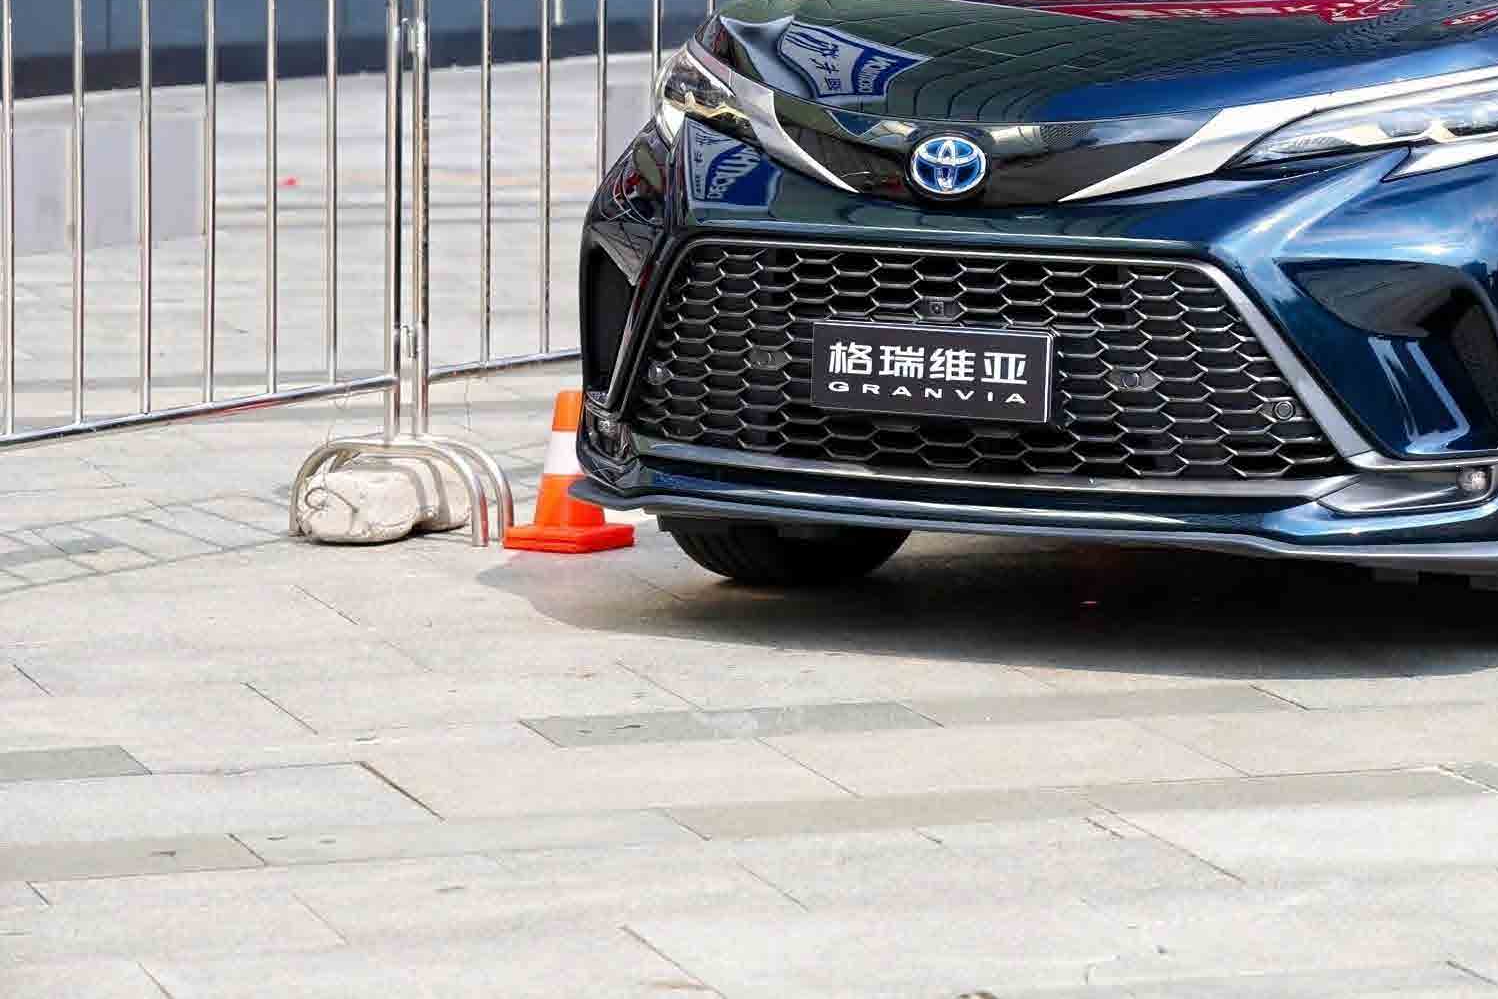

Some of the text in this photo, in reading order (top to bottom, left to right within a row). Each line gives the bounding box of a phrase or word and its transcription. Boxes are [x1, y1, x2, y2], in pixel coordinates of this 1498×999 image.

[827, 341, 1028, 385] 格瑞维亚
[828, 381, 1027, 404] GRANVIA
